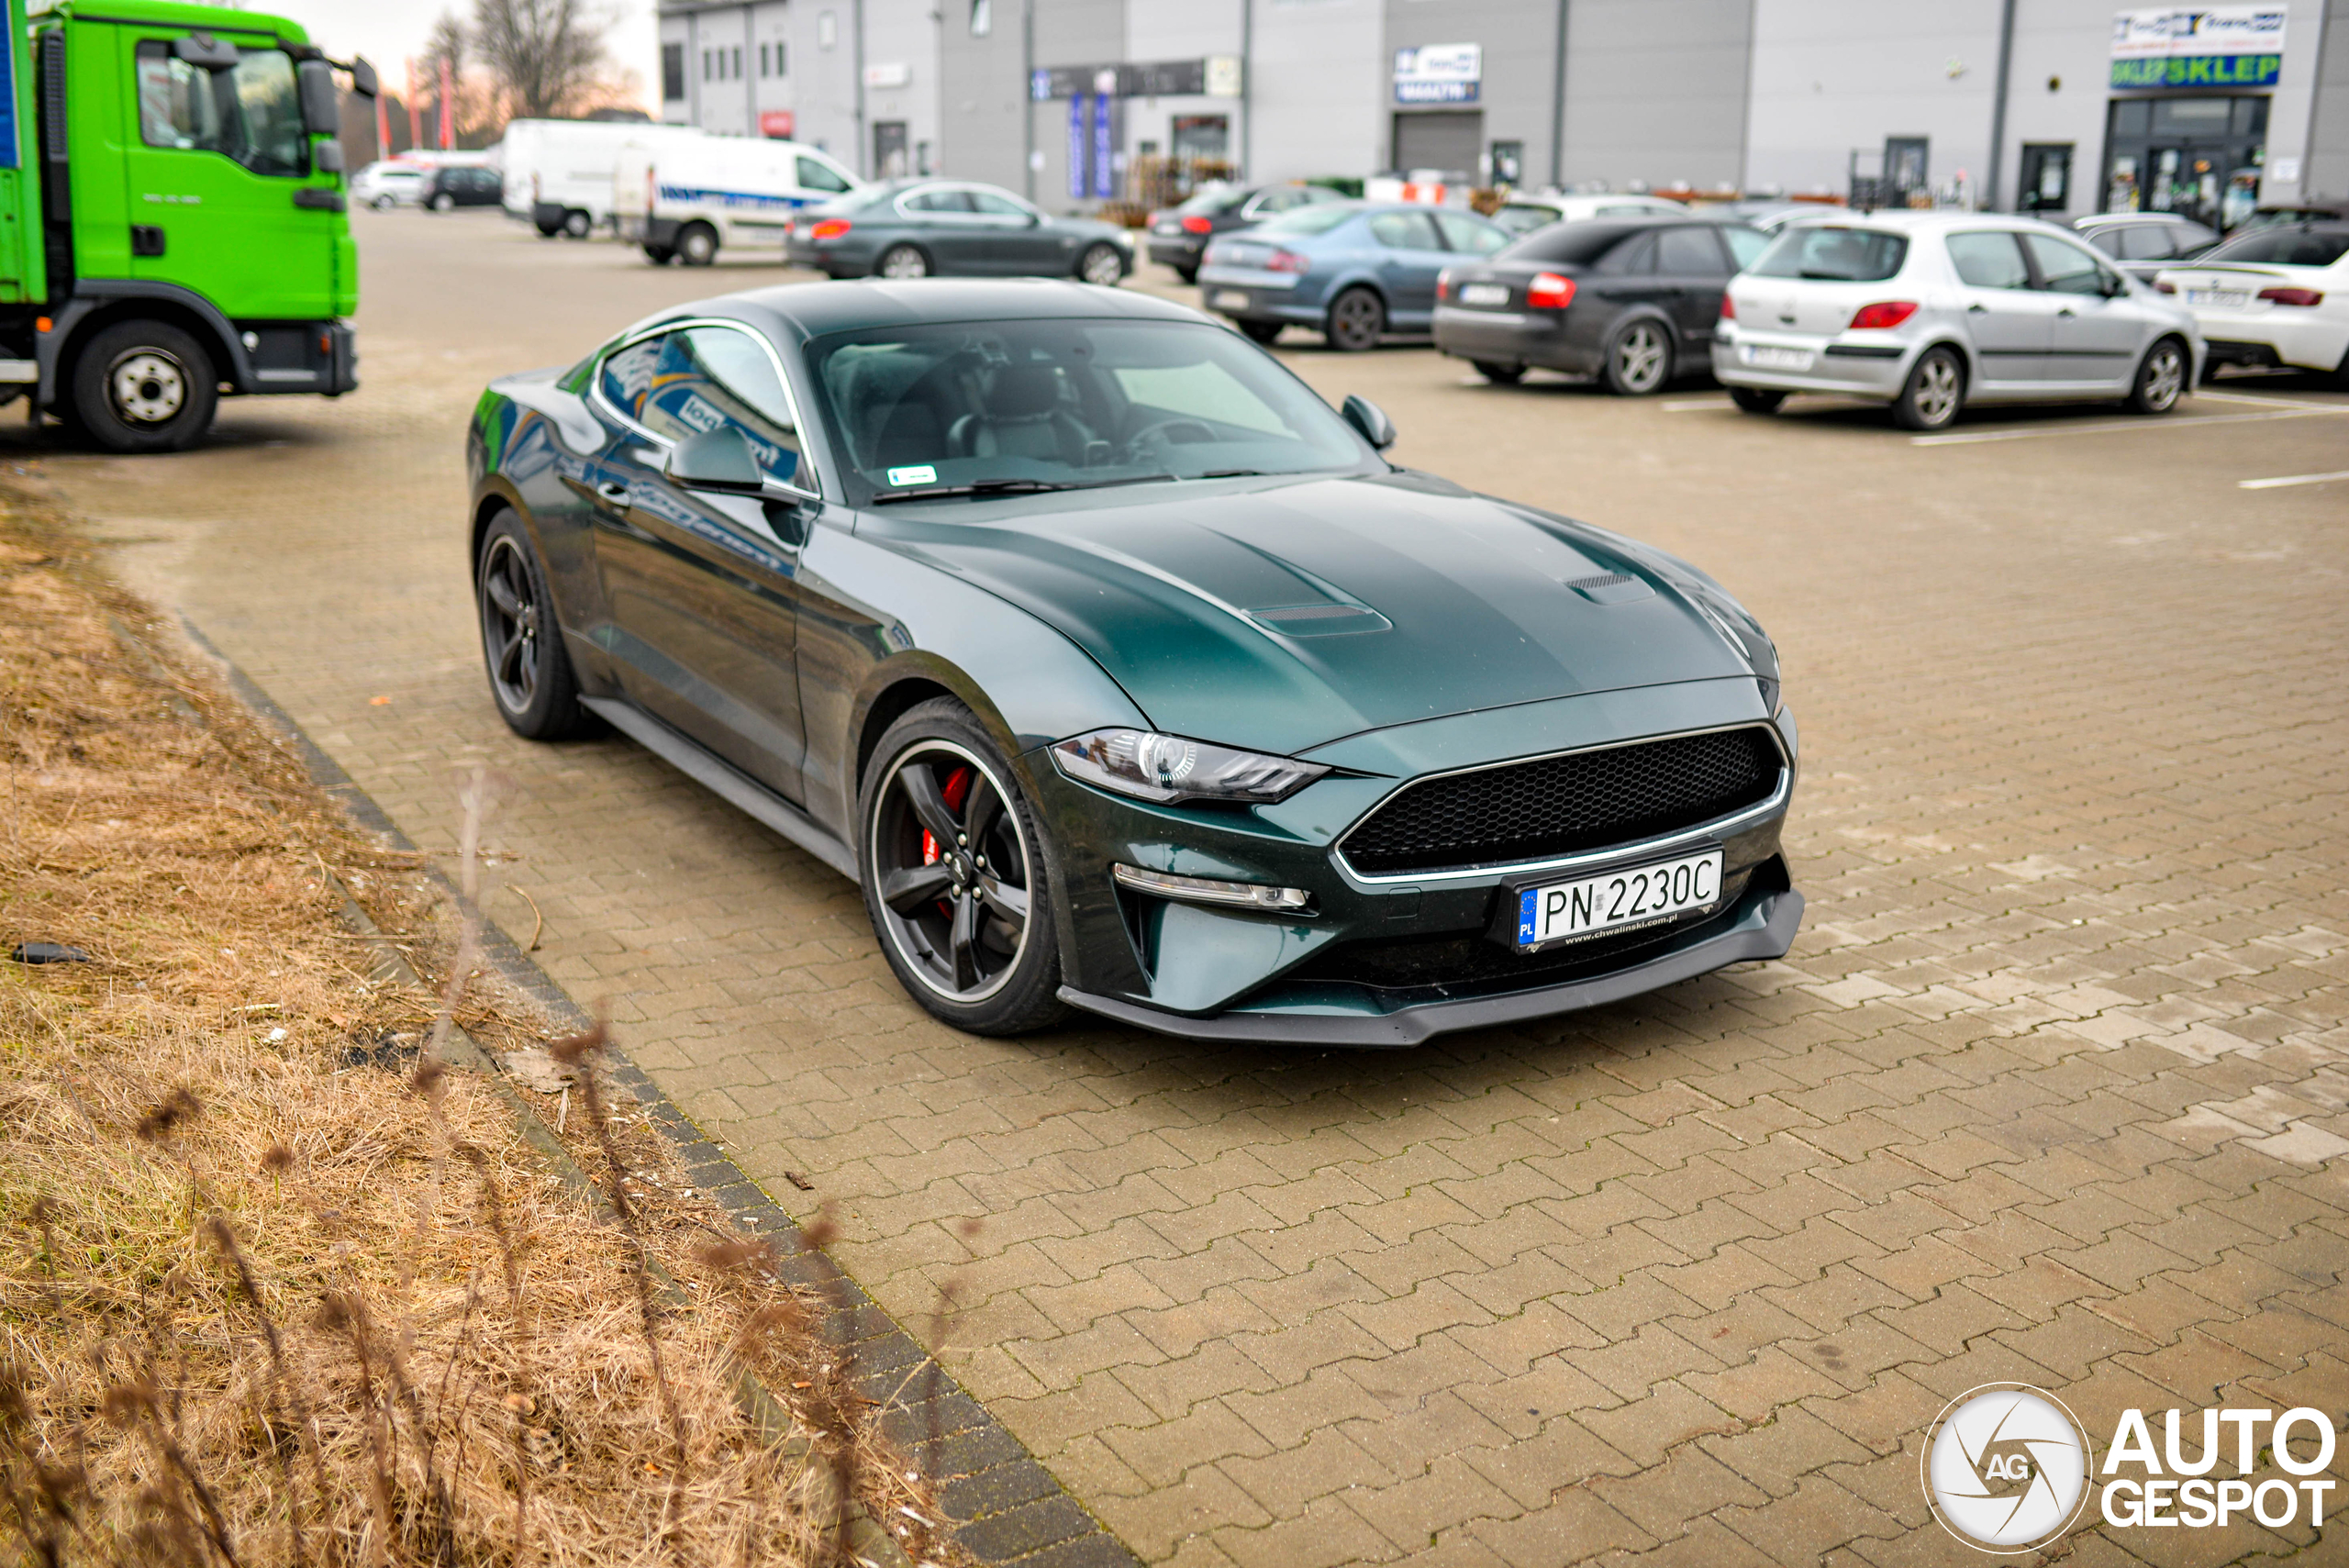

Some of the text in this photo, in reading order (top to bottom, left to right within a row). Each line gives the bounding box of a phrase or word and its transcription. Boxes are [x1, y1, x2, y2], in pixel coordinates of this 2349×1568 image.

[2167, 56, 2279, 83] SKLEP
[1017, 799, 1048, 910] MICHELIN
[1544, 859, 1712, 935] PN 2230C
[1520, 923, 1533, 938] PL
[1564, 915, 1678, 945] www.chwalinski.com.pl
